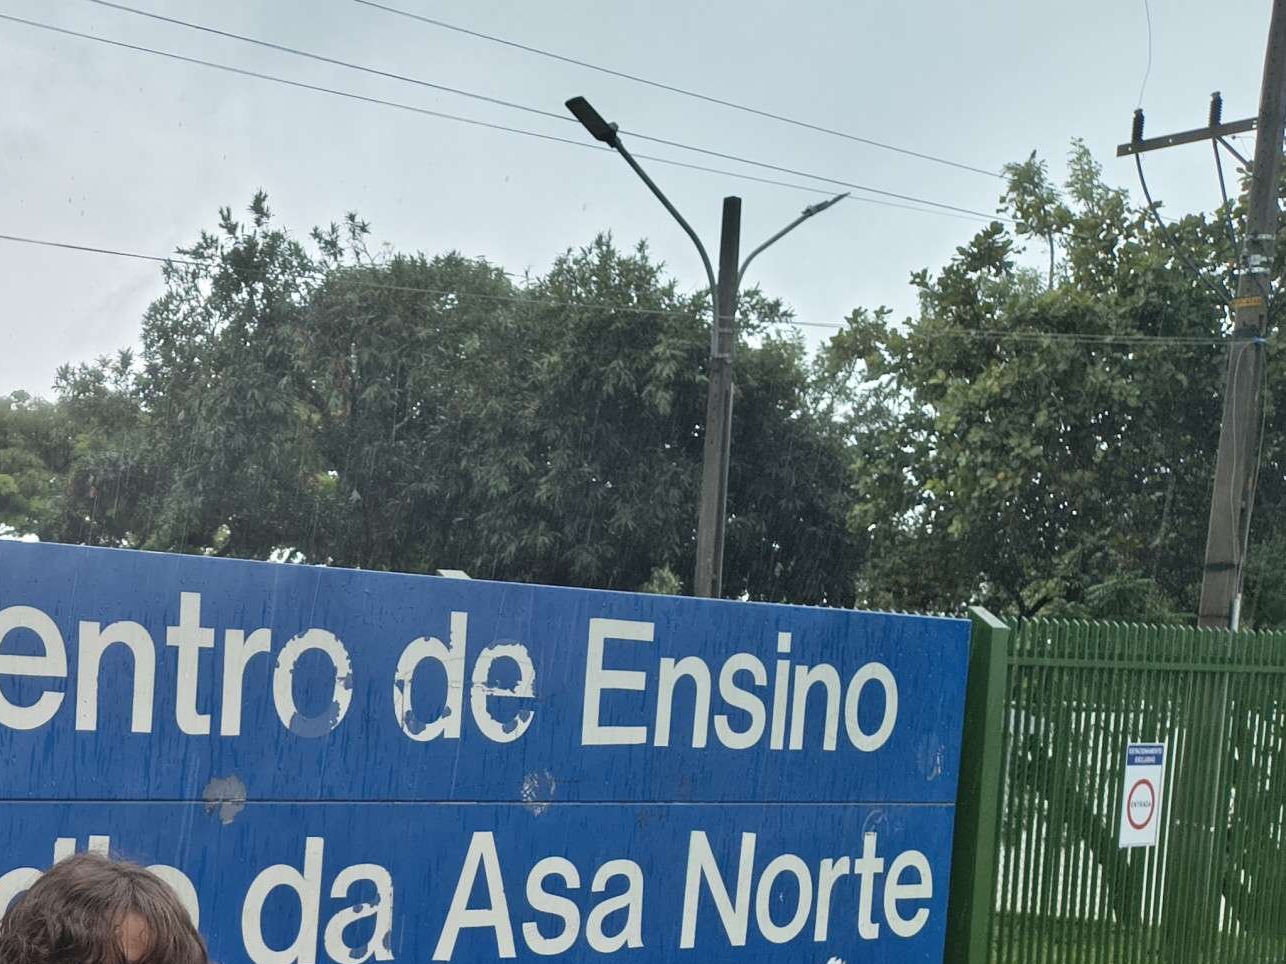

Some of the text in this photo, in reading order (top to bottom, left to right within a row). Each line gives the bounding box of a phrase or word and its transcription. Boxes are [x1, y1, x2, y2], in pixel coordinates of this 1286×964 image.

[393, 610, 537, 743] de
[580, 617, 899, 753] Ensino
[431, 830, 646, 962] Asa
[679, 830, 933, 950] Norte
